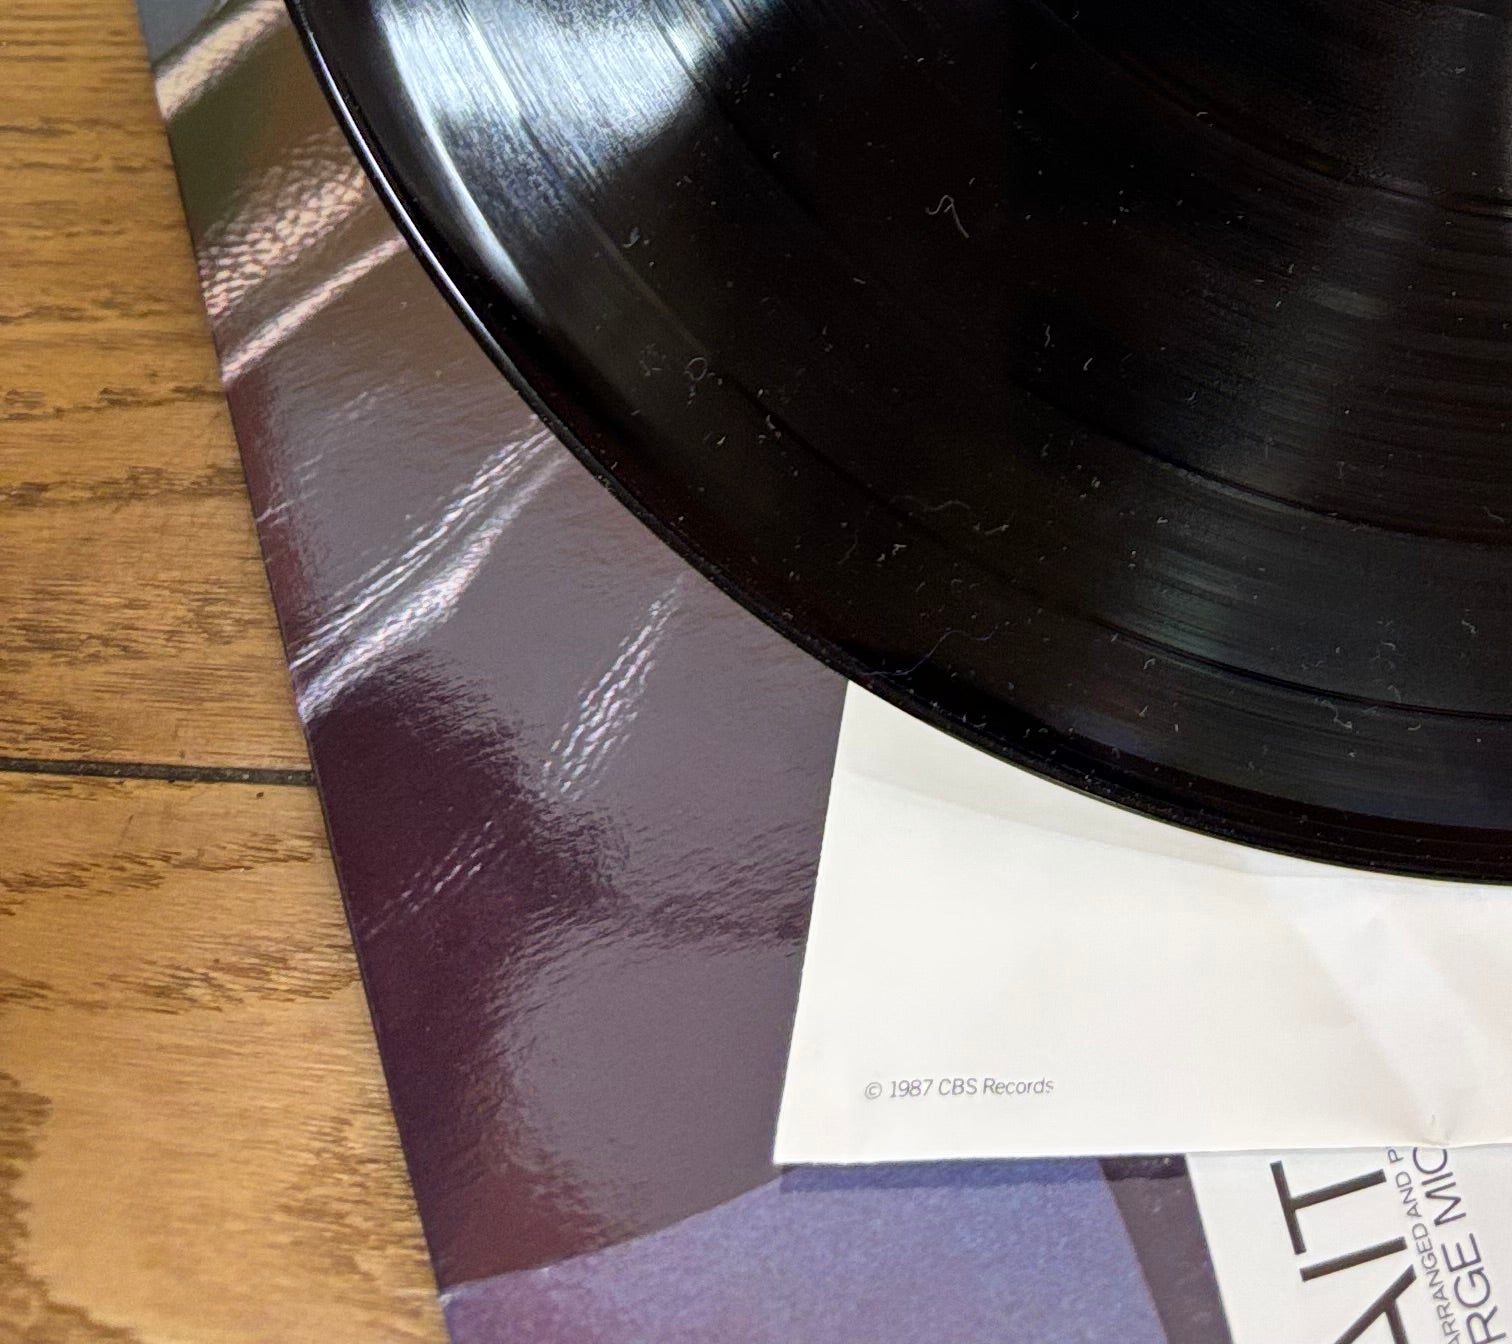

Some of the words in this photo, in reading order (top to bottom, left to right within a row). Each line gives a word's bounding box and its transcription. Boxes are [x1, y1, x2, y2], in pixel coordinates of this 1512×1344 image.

[889, 1078, 934, 1099] 1987
[938, 1077, 978, 1096] CBS
[983, 1076, 1056, 1096] Records
[1394, 1170, 1423, 1219] AND
